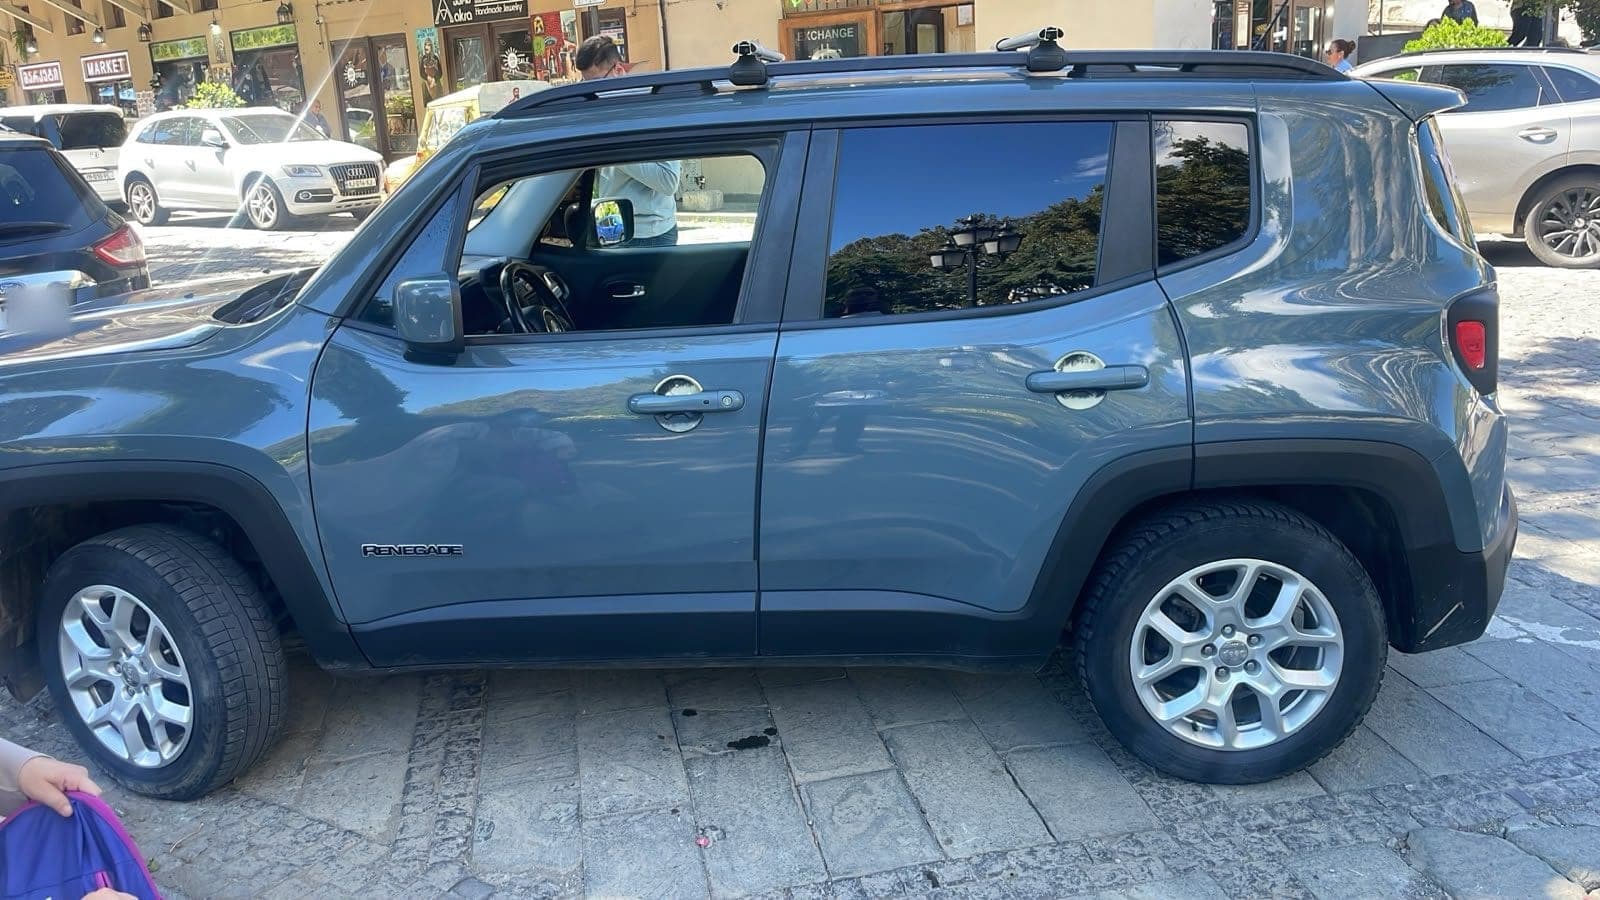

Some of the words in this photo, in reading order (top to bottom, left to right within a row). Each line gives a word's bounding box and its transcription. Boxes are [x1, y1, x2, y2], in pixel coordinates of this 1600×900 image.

[797, 27, 854, 41] EXCHANGE
[87, 58, 124, 76] MARKET
[361, 544, 463, 557] RENEGADE
